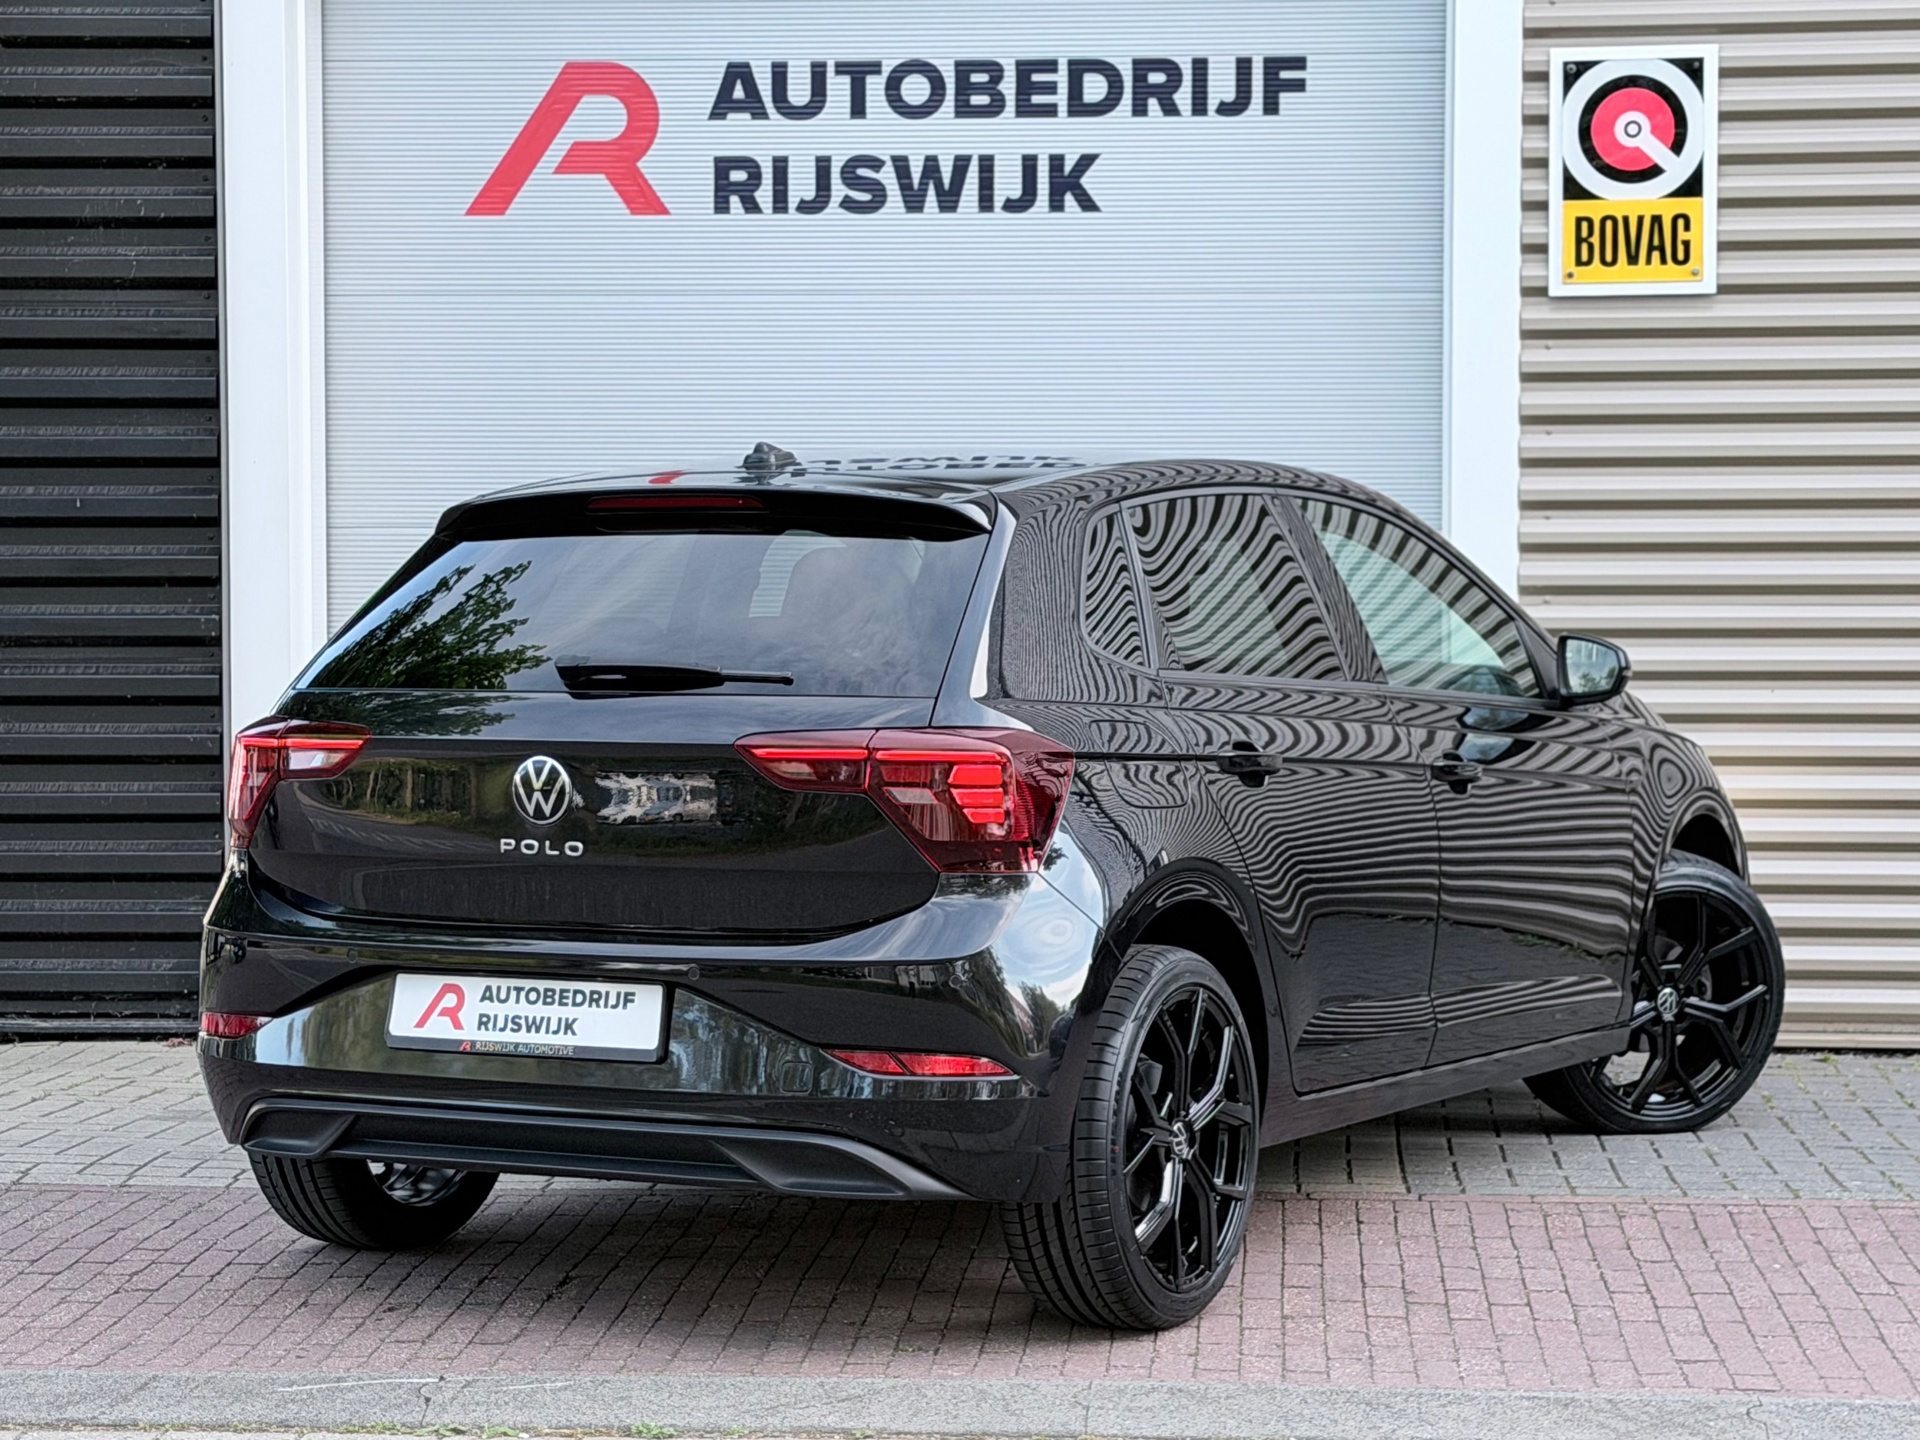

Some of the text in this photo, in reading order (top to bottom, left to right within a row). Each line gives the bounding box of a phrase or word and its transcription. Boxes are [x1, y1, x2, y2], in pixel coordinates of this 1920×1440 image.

[708, 56, 1308, 120] AUTOBEDRIJF
[713, 154, 1102, 215] RIJSWIJK
[1574, 213, 1692, 267] BOVAG
[499, 838, 585, 857] POLO
[478, 984, 637, 1010] AUTOBEDRIJF
[476, 1012, 579, 1036] RIJSWIJK
[475, 1041, 575, 1056] RIJSWIJK AUTOMOTIVE
